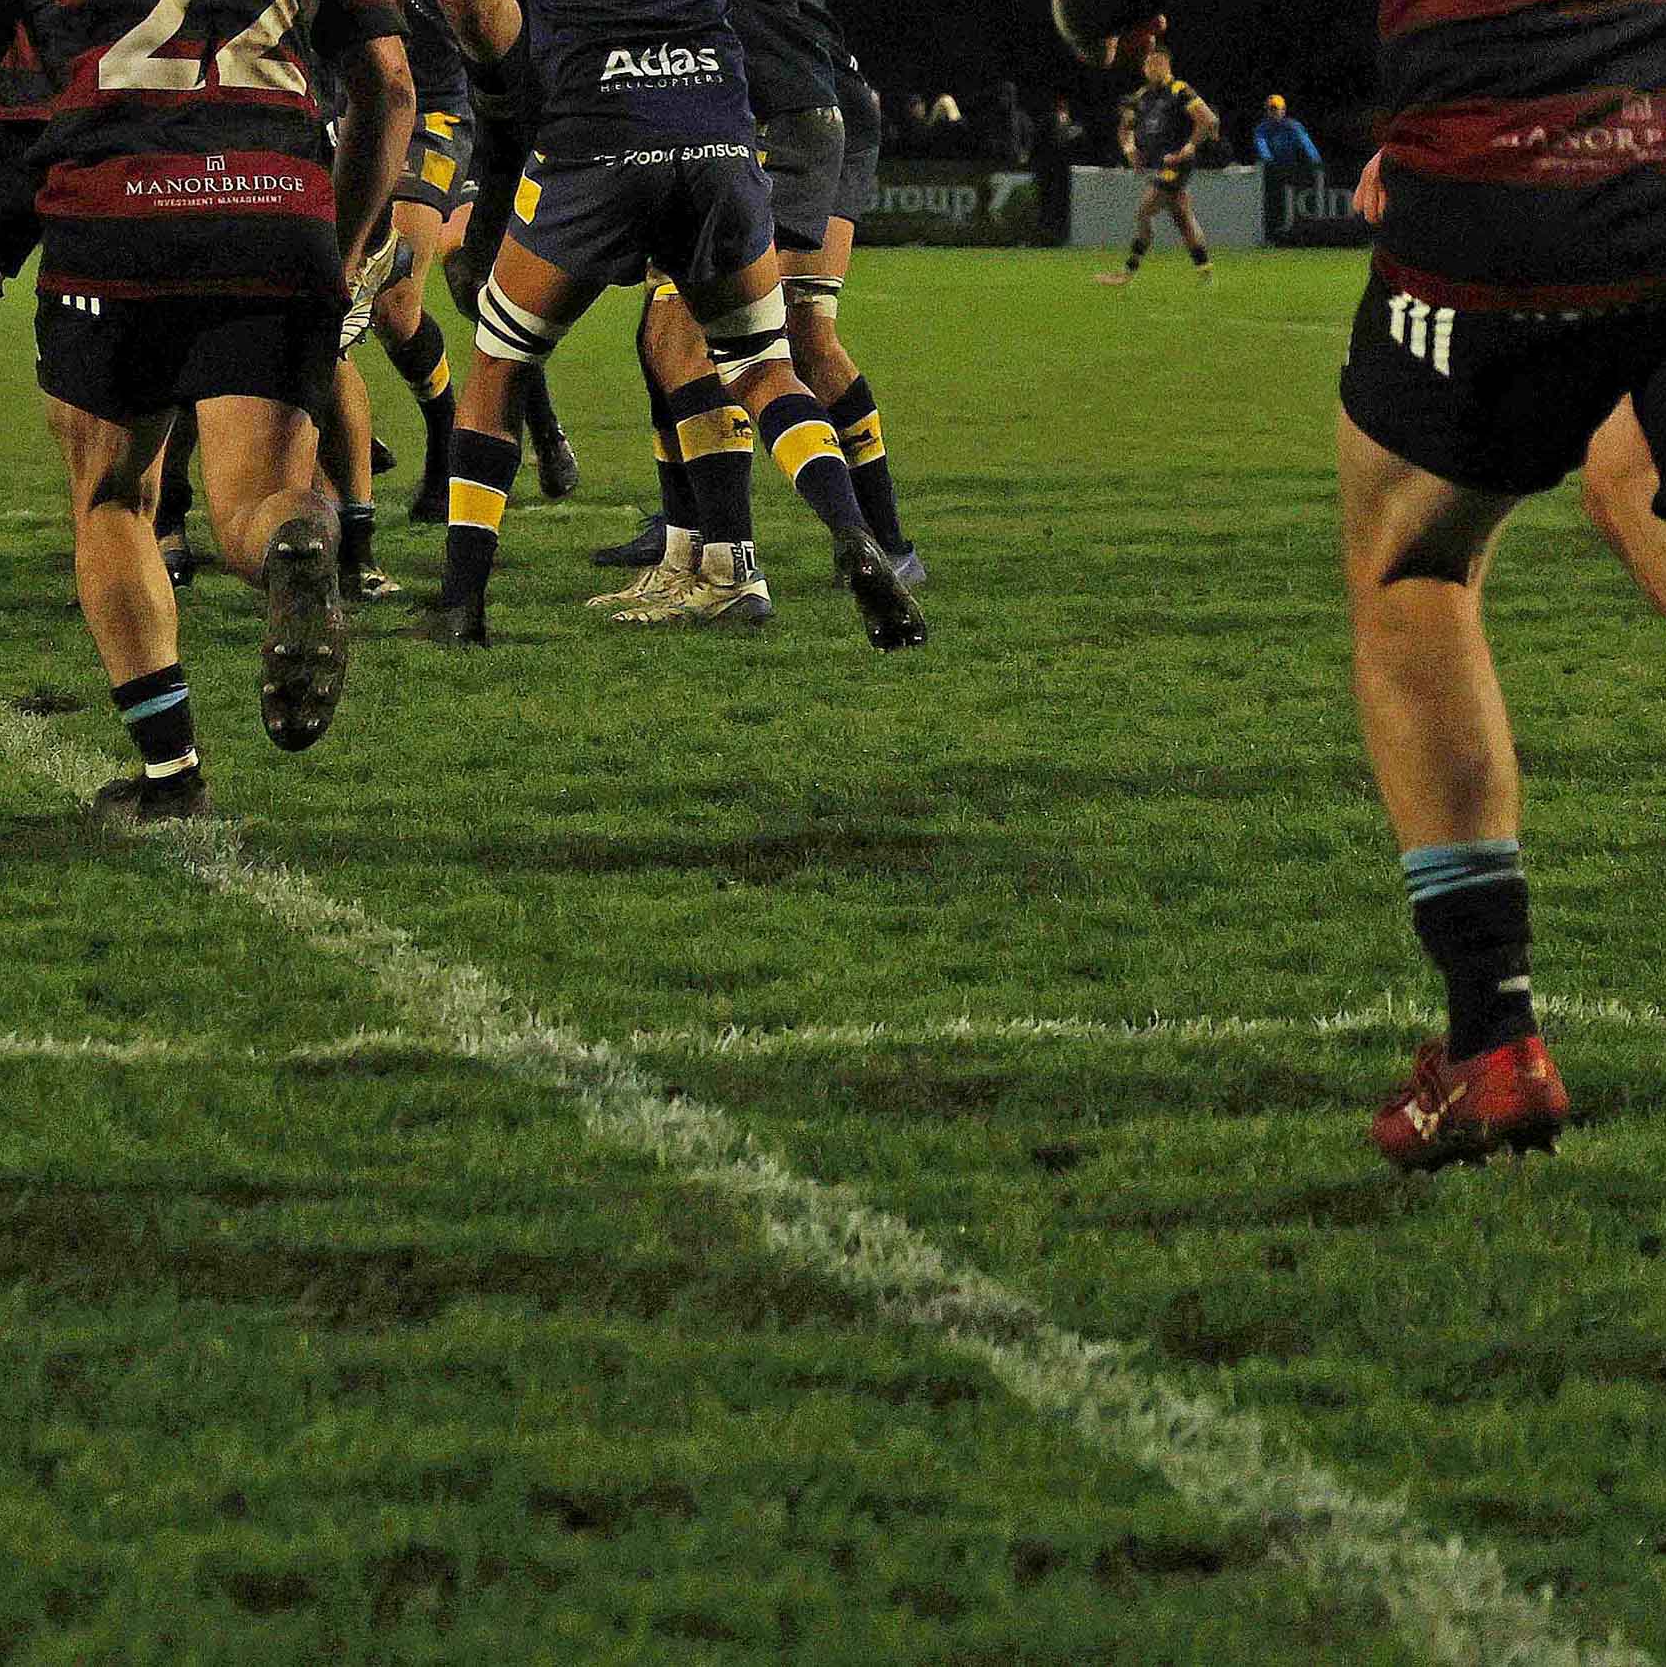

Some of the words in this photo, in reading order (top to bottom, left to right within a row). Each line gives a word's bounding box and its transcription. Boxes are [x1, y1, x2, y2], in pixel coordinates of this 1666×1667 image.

[599, 41, 719, 82] Atlas
[599, 74, 724, 93] HELICOPTERS
[125, 175, 305, 196] MANORBRIDGE
